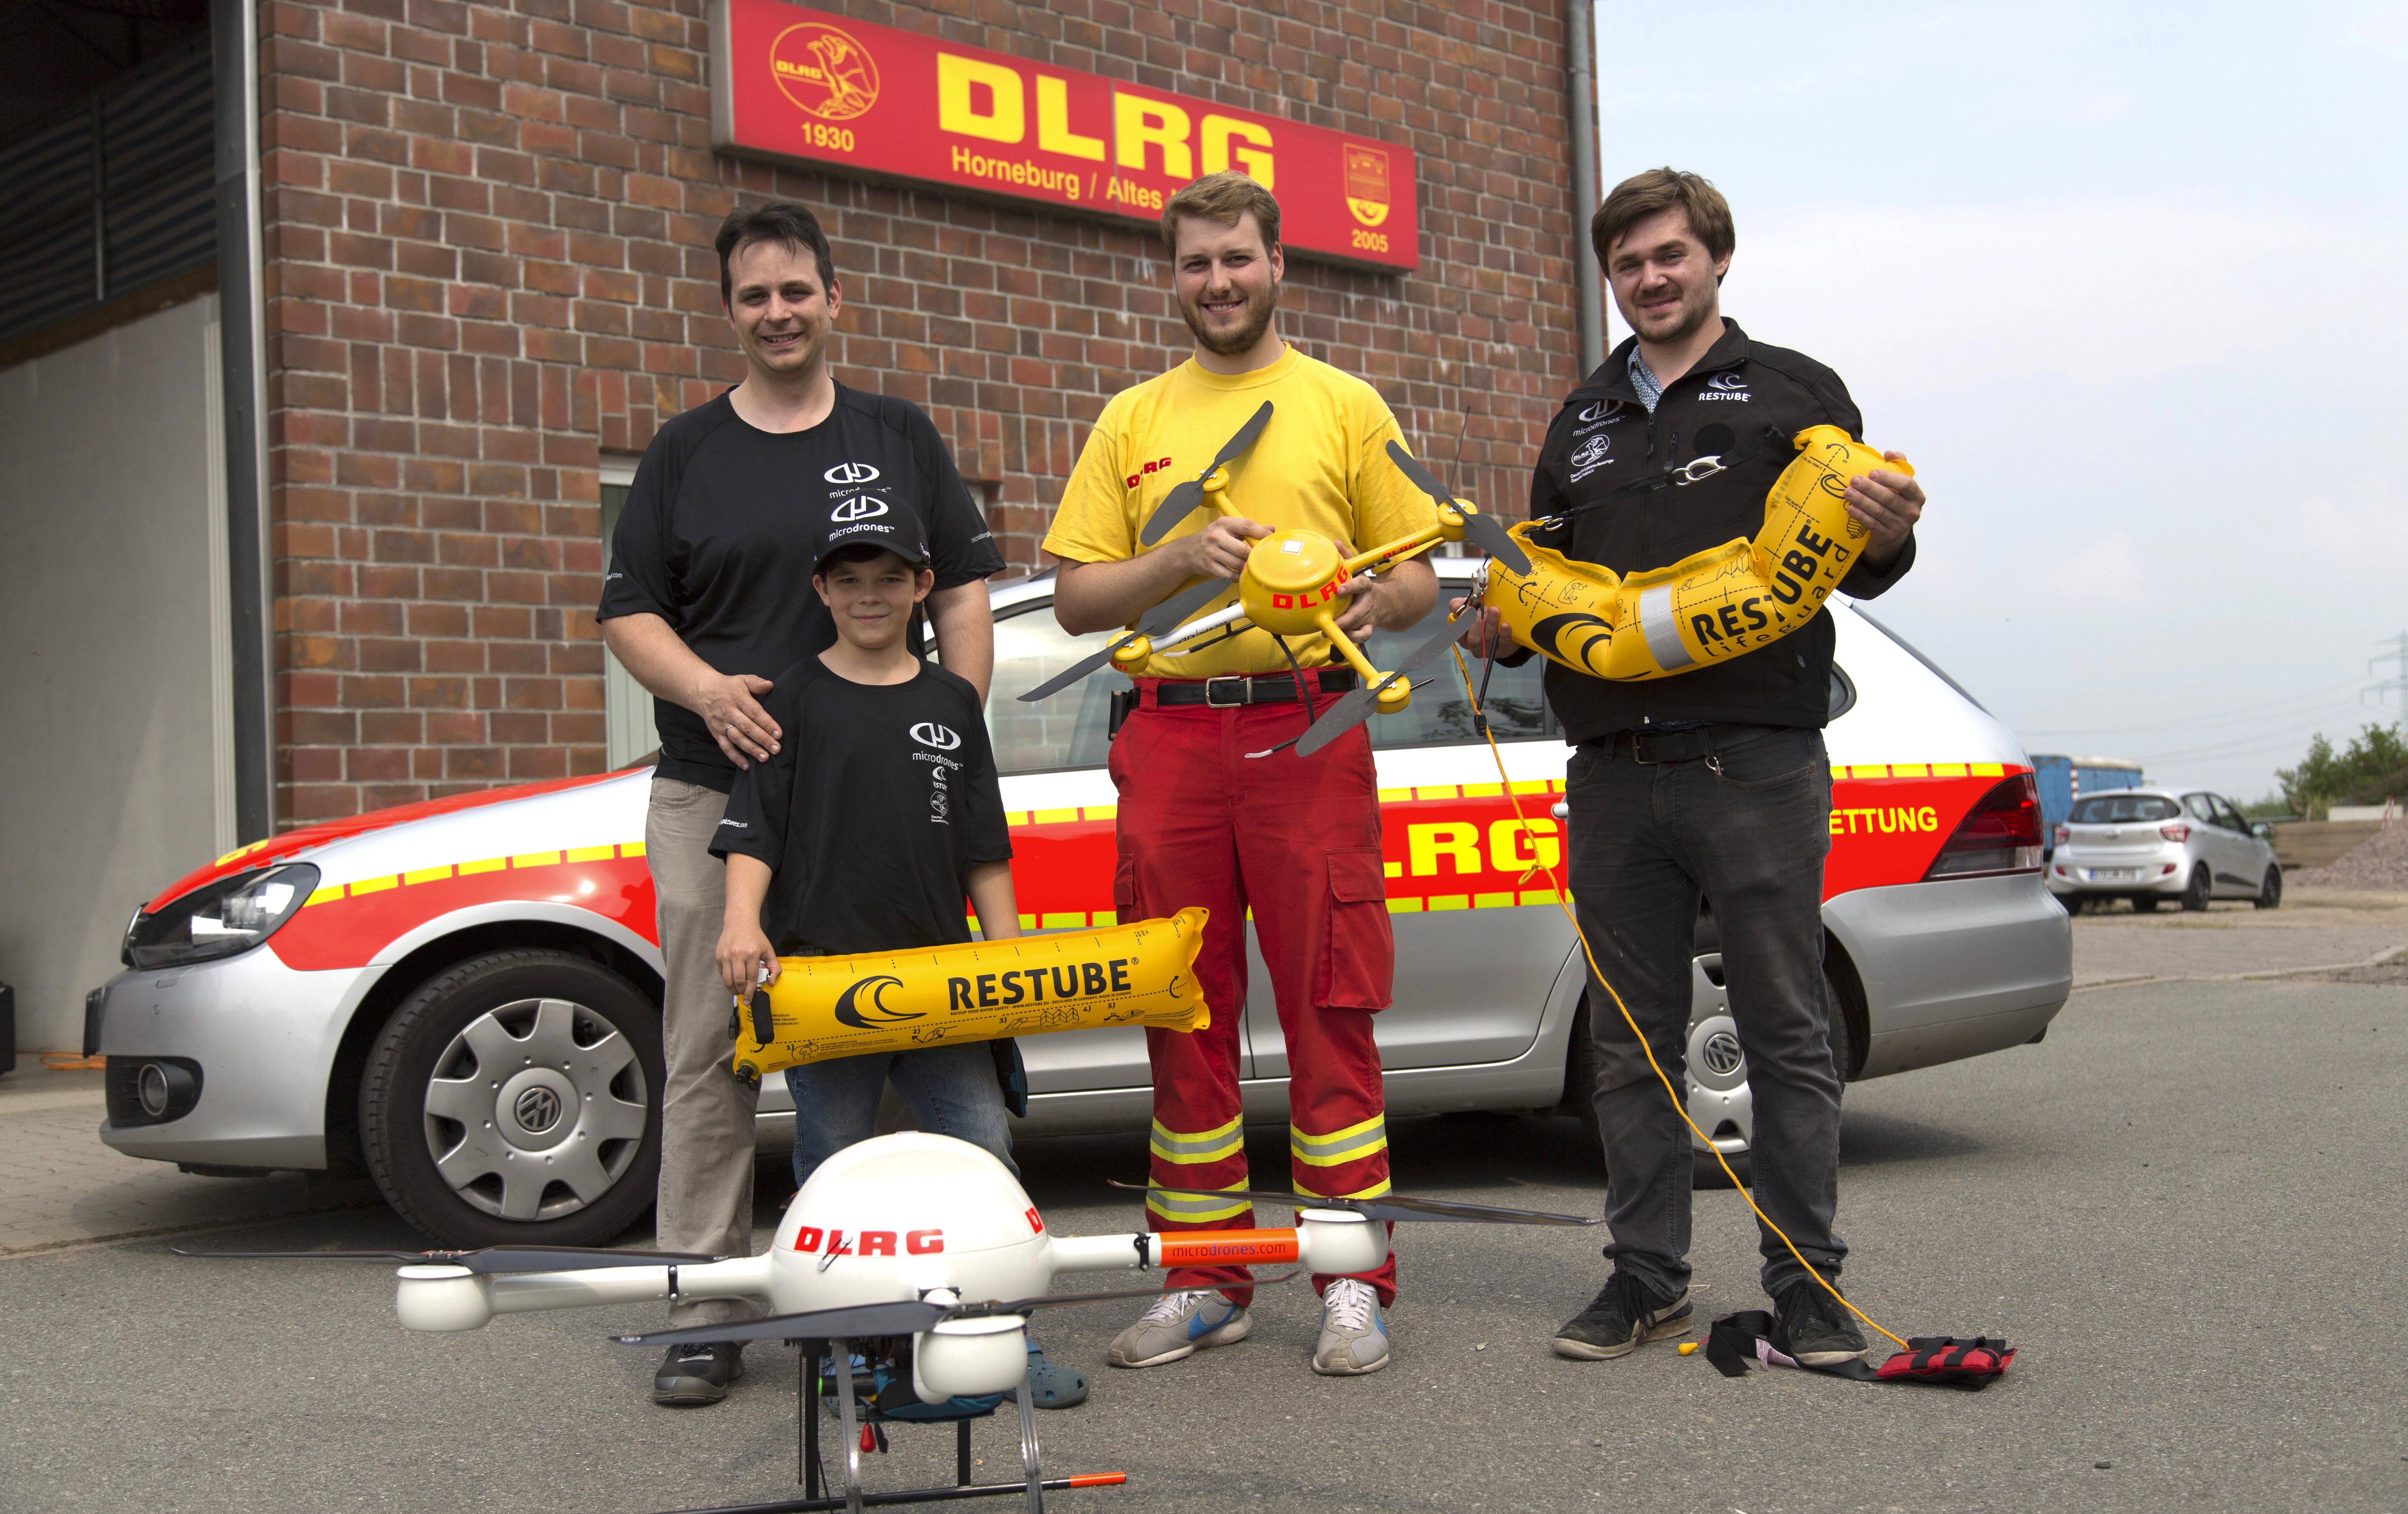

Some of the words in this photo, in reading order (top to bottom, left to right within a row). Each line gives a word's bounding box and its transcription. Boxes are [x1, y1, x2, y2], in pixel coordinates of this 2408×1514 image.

[775, 60, 824, 79] DLRG
[937, 52, 1275, 192] DLRG
[801, 121, 855, 152] 1930
[952, 145, 1080, 200] Horneburg
[1089, 172, 1097, 199] /
[1106, 176, 1163, 210] Altes
[1351, 229, 1388, 253] 2005
[1699, 392, 1749, 402] RESTUBE
[1573, 451, 1589, 460] DLRG
[1127, 457, 1171, 489] DRG
[1273, 565, 1348, 609] DLRG
[1829, 807, 1938, 834] ETTUNG
[794, 1226, 944, 1256] DLRG
[1173, 1244, 1286, 1257] microdrones.com
